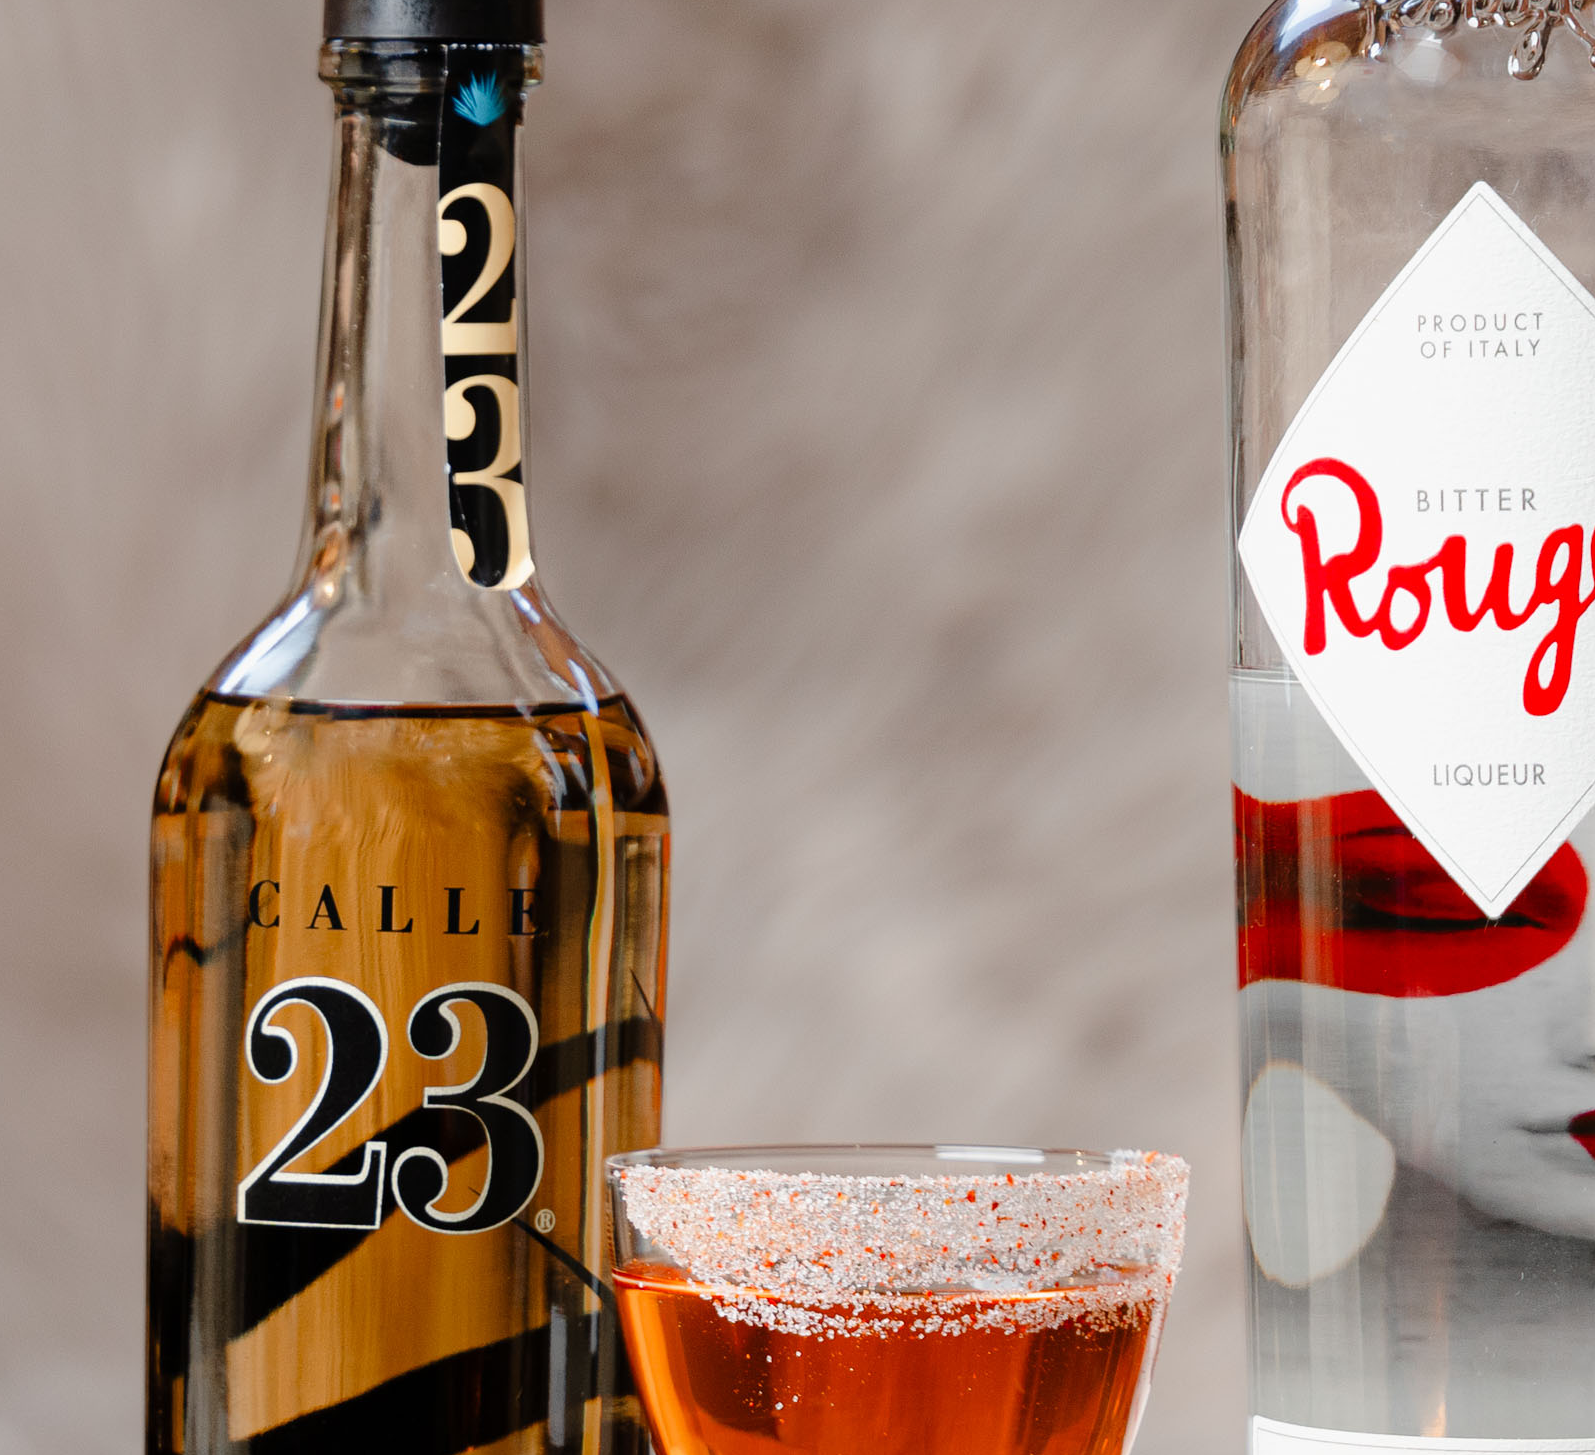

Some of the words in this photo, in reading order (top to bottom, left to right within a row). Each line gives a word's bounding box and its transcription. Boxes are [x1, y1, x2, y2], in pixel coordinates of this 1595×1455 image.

[1417, 312, 1543, 333] PRODUCT
[1420, 340, 1452, 359] OF
[1469, 339, 1541, 358] ITALY
[1416, 489, 1538, 513] BITTER
[1433, 763, 1546, 787] LIQUEUR
[248, 879, 544, 936] CALLE
